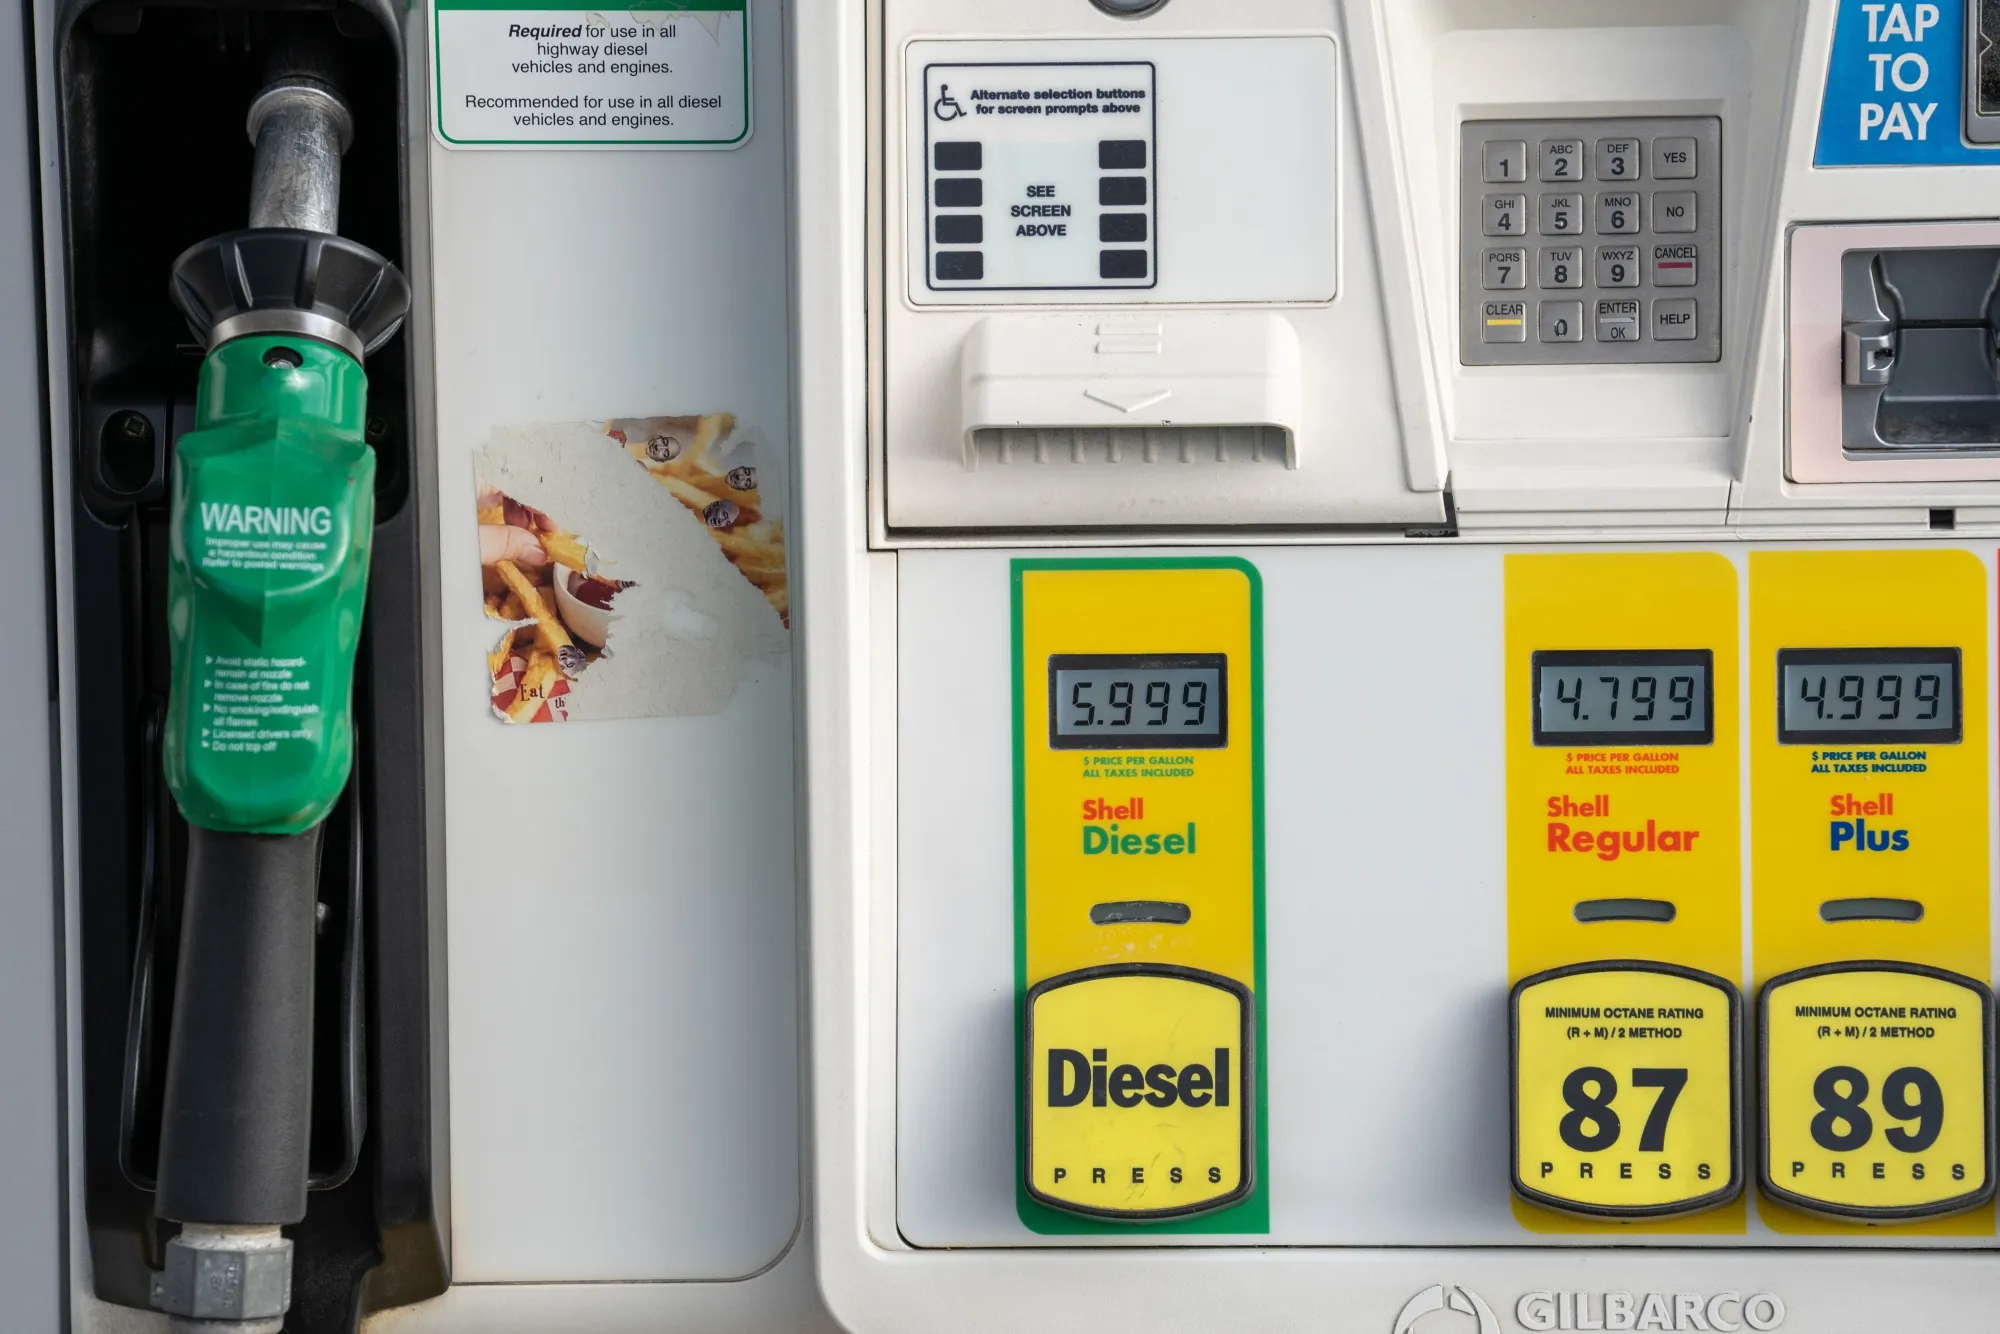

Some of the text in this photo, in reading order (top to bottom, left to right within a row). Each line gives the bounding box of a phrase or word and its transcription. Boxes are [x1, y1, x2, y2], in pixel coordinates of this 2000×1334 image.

[1862, 3, 1939, 42] TAP
[509, 24, 676, 39] Required for use in all
[538, 43, 648, 58] highway diesel
[512, 61, 673, 76] vehicles and engines.
[1869, 53, 1929, 92] TO
[971, 89, 1145, 100] Alternate selection buttons
[466, 95, 721, 108] Recommended for use in all diesel
[976, 103, 1140, 116] for screen prompts above
[513, 113, 674, 128] vehicles and engines.
[1859, 102, 1938, 140] PAY
[1550, 145, 1573, 154] ABC
[1608, 144, 1629, 153] DEF
[1664, 153, 1686, 162] YES
[1499, 160, 1508, 177] 1
[1554, 159, 1568, 176] 2
[1611, 157, 1625, 175] 3
[1027, 186, 1055, 197] SEE
[1495, 200, 1514, 209] GHI
[1551, 199, 1570, 208] JKL
[1605, 198, 1631, 206] MNO
[1011, 205, 1071, 217] SCREEN
[1666, 207, 1684, 217] NO
[1498, 213, 1511, 230] 4
[1554, 212, 1567, 229] 5
[1611, 211, 1624, 228] 6
[1016, 225, 1066, 236] ABOVE
[1489, 253, 1520, 262] PQRS
[1550, 253, 1571, 261] TUV
[1602, 252, 1633, 260] WXYZ
[1655, 248, 1695, 258] CANCEL
[1498, 267, 1511, 283] 7
[1554, 265, 1567, 282] 8
[1611, 265, 1624, 282] 9
[1487, 305, 1523, 315] CLEAR
[1599, 303, 1636, 313] ENTER
[1660, 315, 1690, 324] HELP
[1554, 319, 1567, 336] 0
[1611, 328, 1625, 338] OK
[201, 502, 331, 535] WARNING
[206, 538, 326, 550] Improper use may cause
[218, 550, 268, 558] hazardous
[202, 558, 229, 567] Refer
[232, 558, 242, 568] to
[244, 559, 277, 570] posted
[520, 683, 545, 701] Eat
[1557, 677, 1694, 720] 4.799
[1801, 675, 1940, 720] 4.999
[1072, 682, 1207, 726] 5.999
[1084, 756, 1194, 766] $ PRICE PER GALLON
[1566, 753, 1678, 762] $ PRICE PER GALLON
[1812, 751, 1926, 762] $ PRICE PER GALLON
[1083, 768, 1194, 777] ALL TAXES INCLUDED
[1566, 765, 1679, 774] ALL TAXES INCLUDED
[1811, 764, 1927, 772] ALL TAXES INCLUDED
[1082, 798, 1143, 820] Shell
[1548, 795, 1609, 817] Shell
[1830, 793, 1893, 816] Shell
[1083, 823, 1196, 854] Diesel
[1548, 820, 1699, 861] Regular
[1830, 819, 1909, 851] Plus
[1546, 1007, 1703, 1018] MINIMUM OCTANE RATING
[1796, 1006, 1956, 1018] MINIMUM OCTANE RATING
[1618, 1028, 1625, 1038] 2
[1629, 1028, 1682, 1038] METHOD
[1869, 1027, 1876, 1037] 2
[1880, 1027, 1935, 1037] METHOD
[1048, 1048, 1229, 1108] Diesel
[1559, 1067, 1688, 1152] 87
[1810, 1066, 1944, 1153] 89
[1516, 1291, 1786, 1332] GILBARCO
